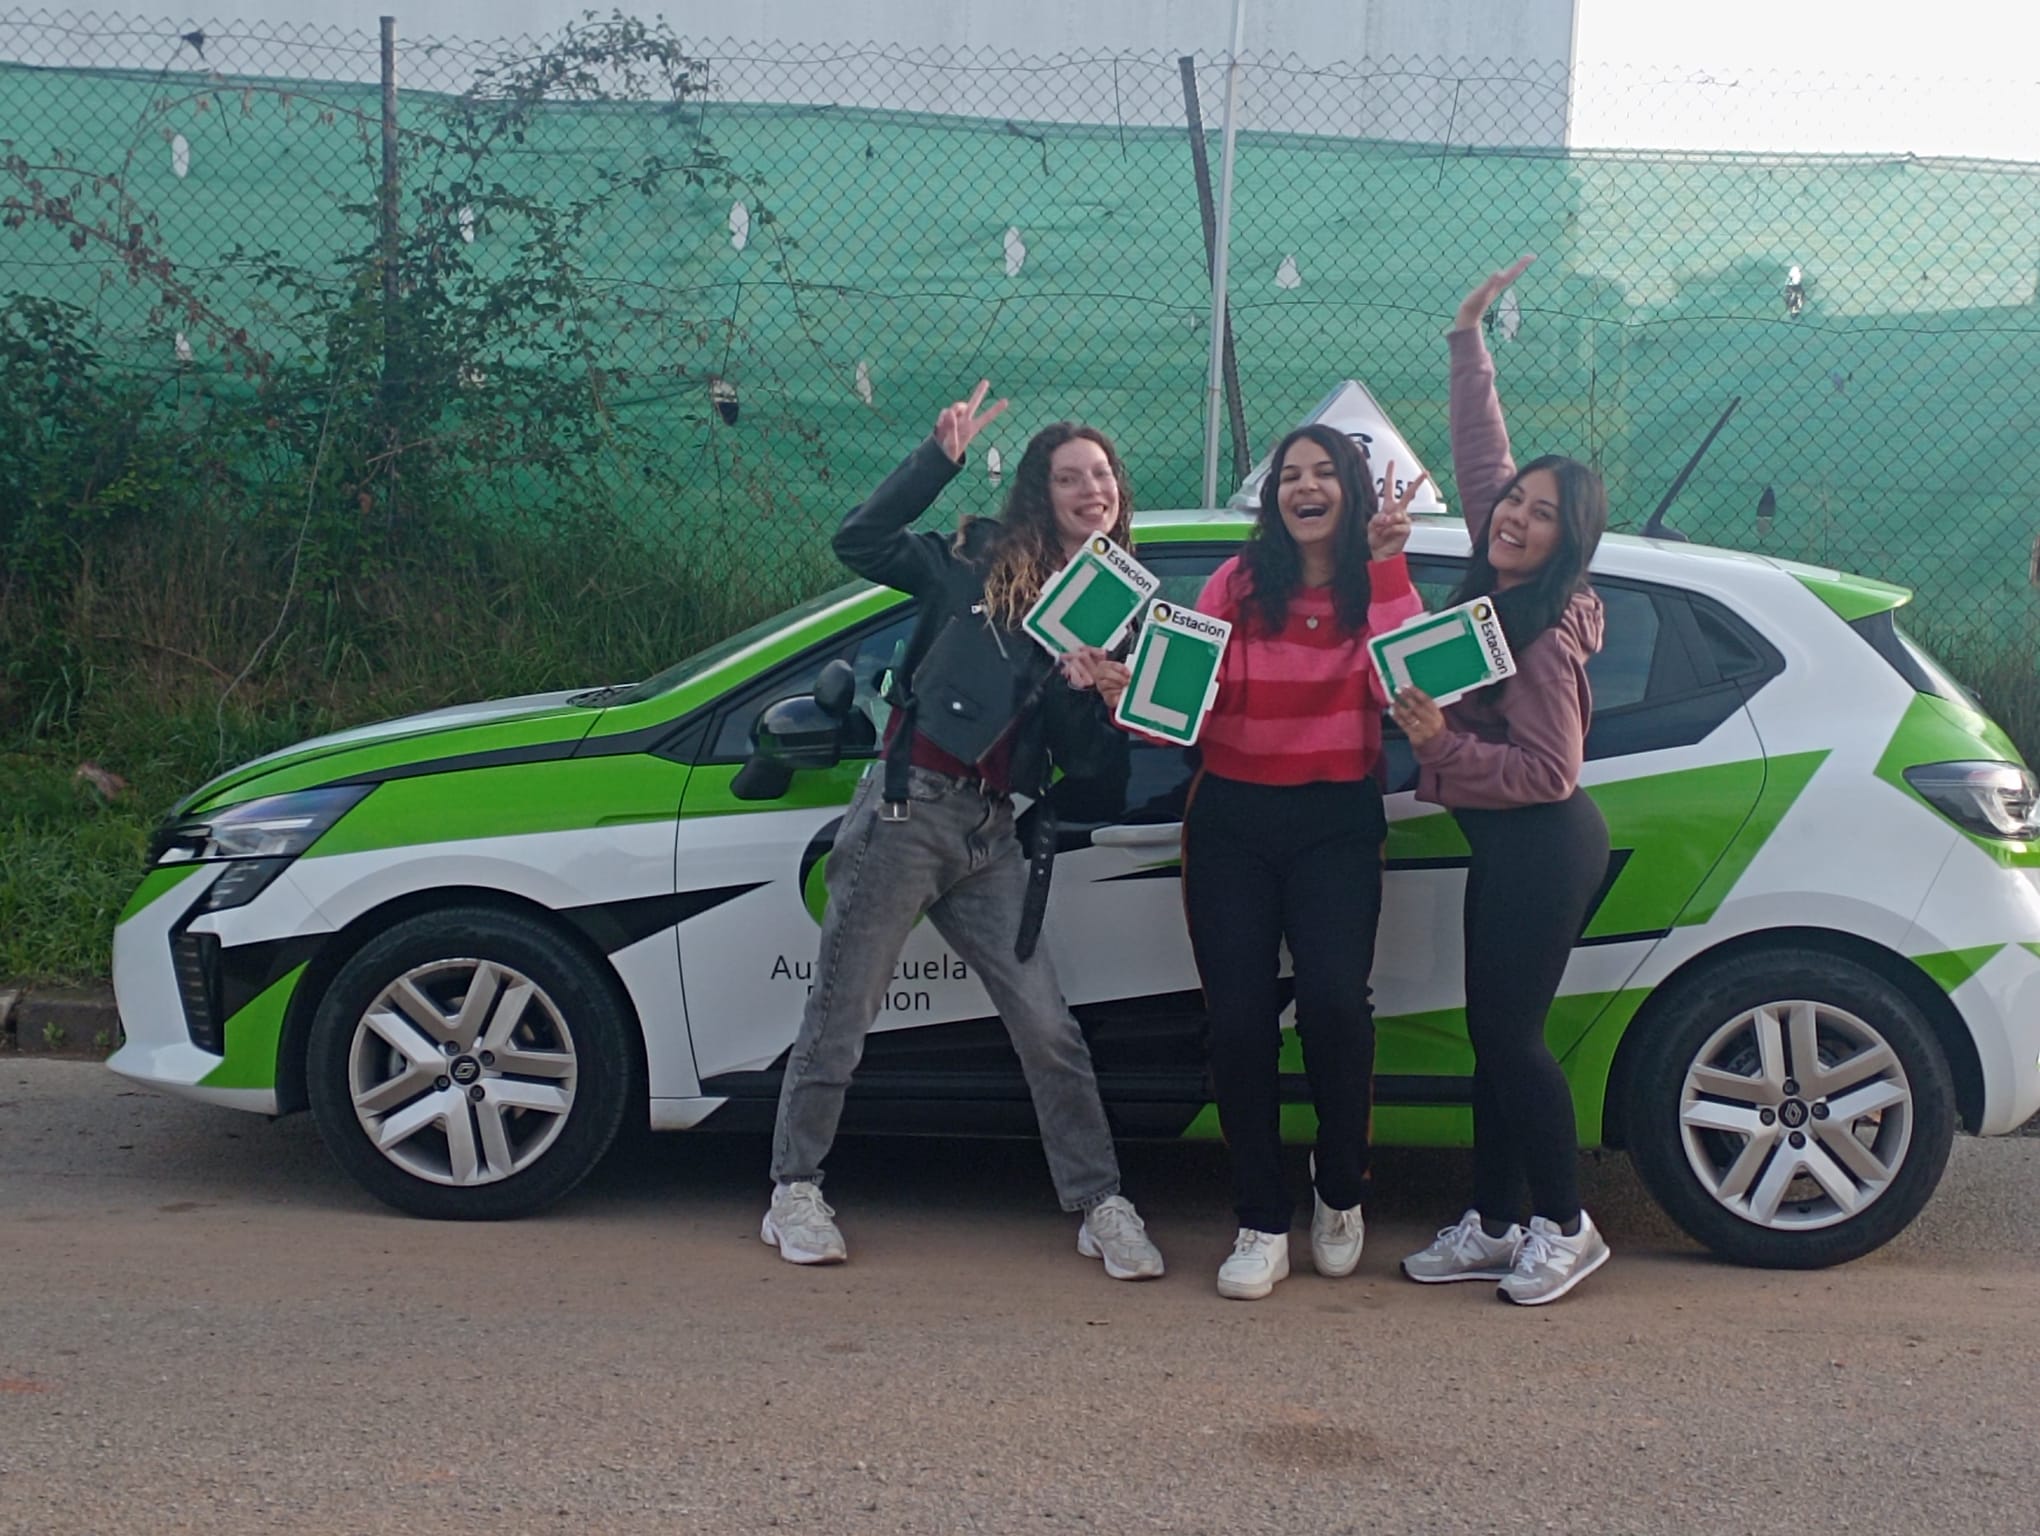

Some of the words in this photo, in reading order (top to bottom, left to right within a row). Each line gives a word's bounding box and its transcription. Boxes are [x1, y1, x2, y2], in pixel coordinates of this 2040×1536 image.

[1106, 550, 1152, 591] Estacion
[1172, 611, 1226, 639] Estacion
[1480, 621, 1508, 675] Estacion
[1129, 633, 1190, 732] L
[770, 954, 968, 980] Auuela
